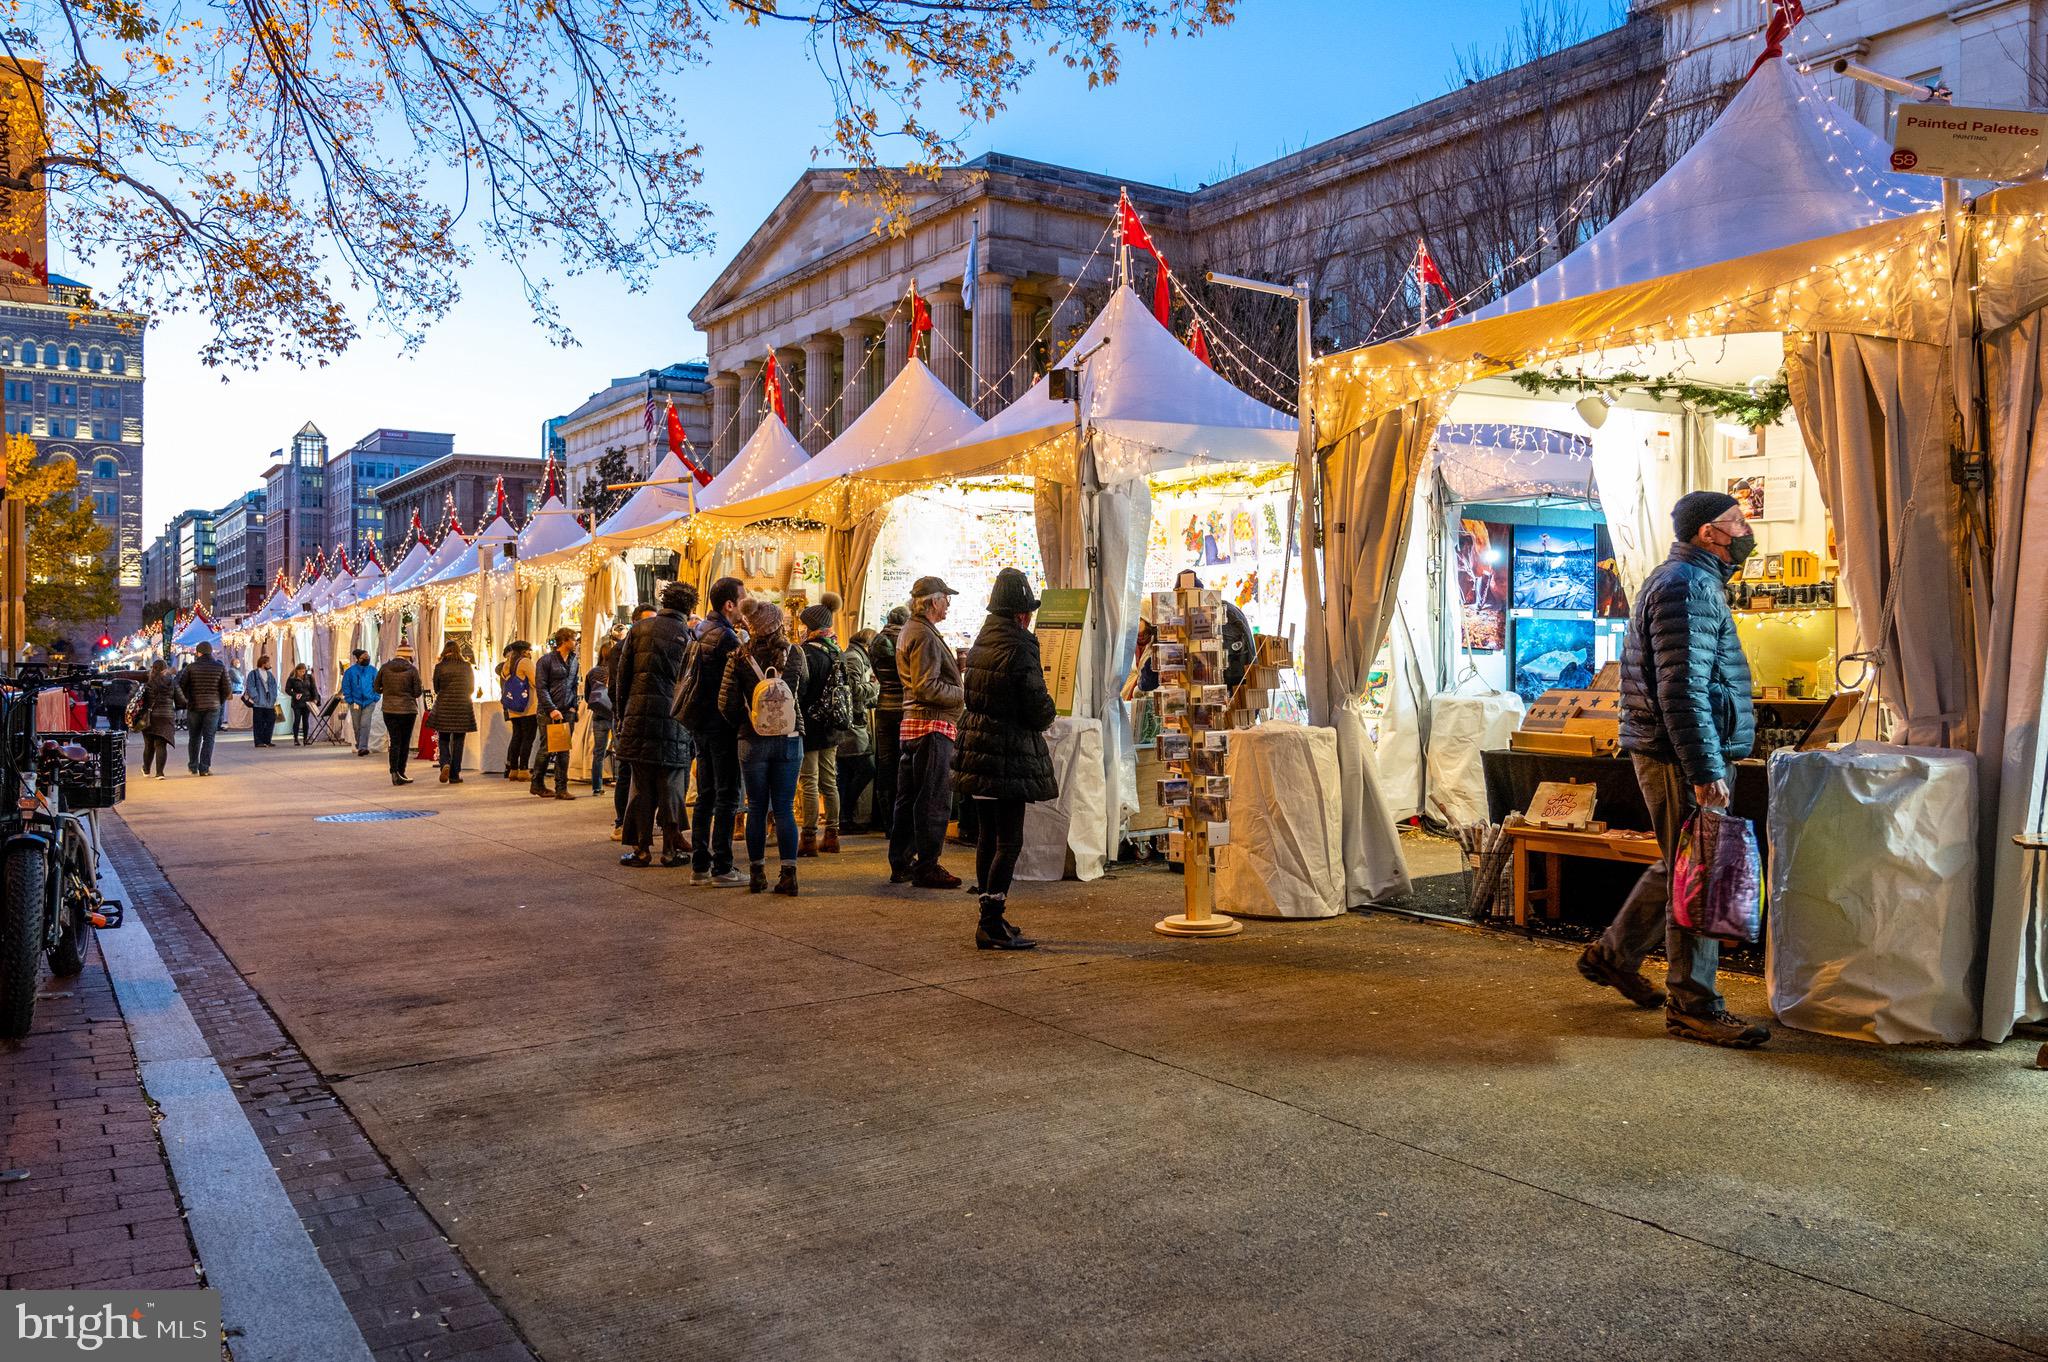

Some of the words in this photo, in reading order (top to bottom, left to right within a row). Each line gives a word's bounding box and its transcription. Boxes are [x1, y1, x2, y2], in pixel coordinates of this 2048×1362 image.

[1907, 117, 1967, 131] Painted
[1972, 121, 2039, 137] Palettes
[1893, 153, 1916, 166] 58
